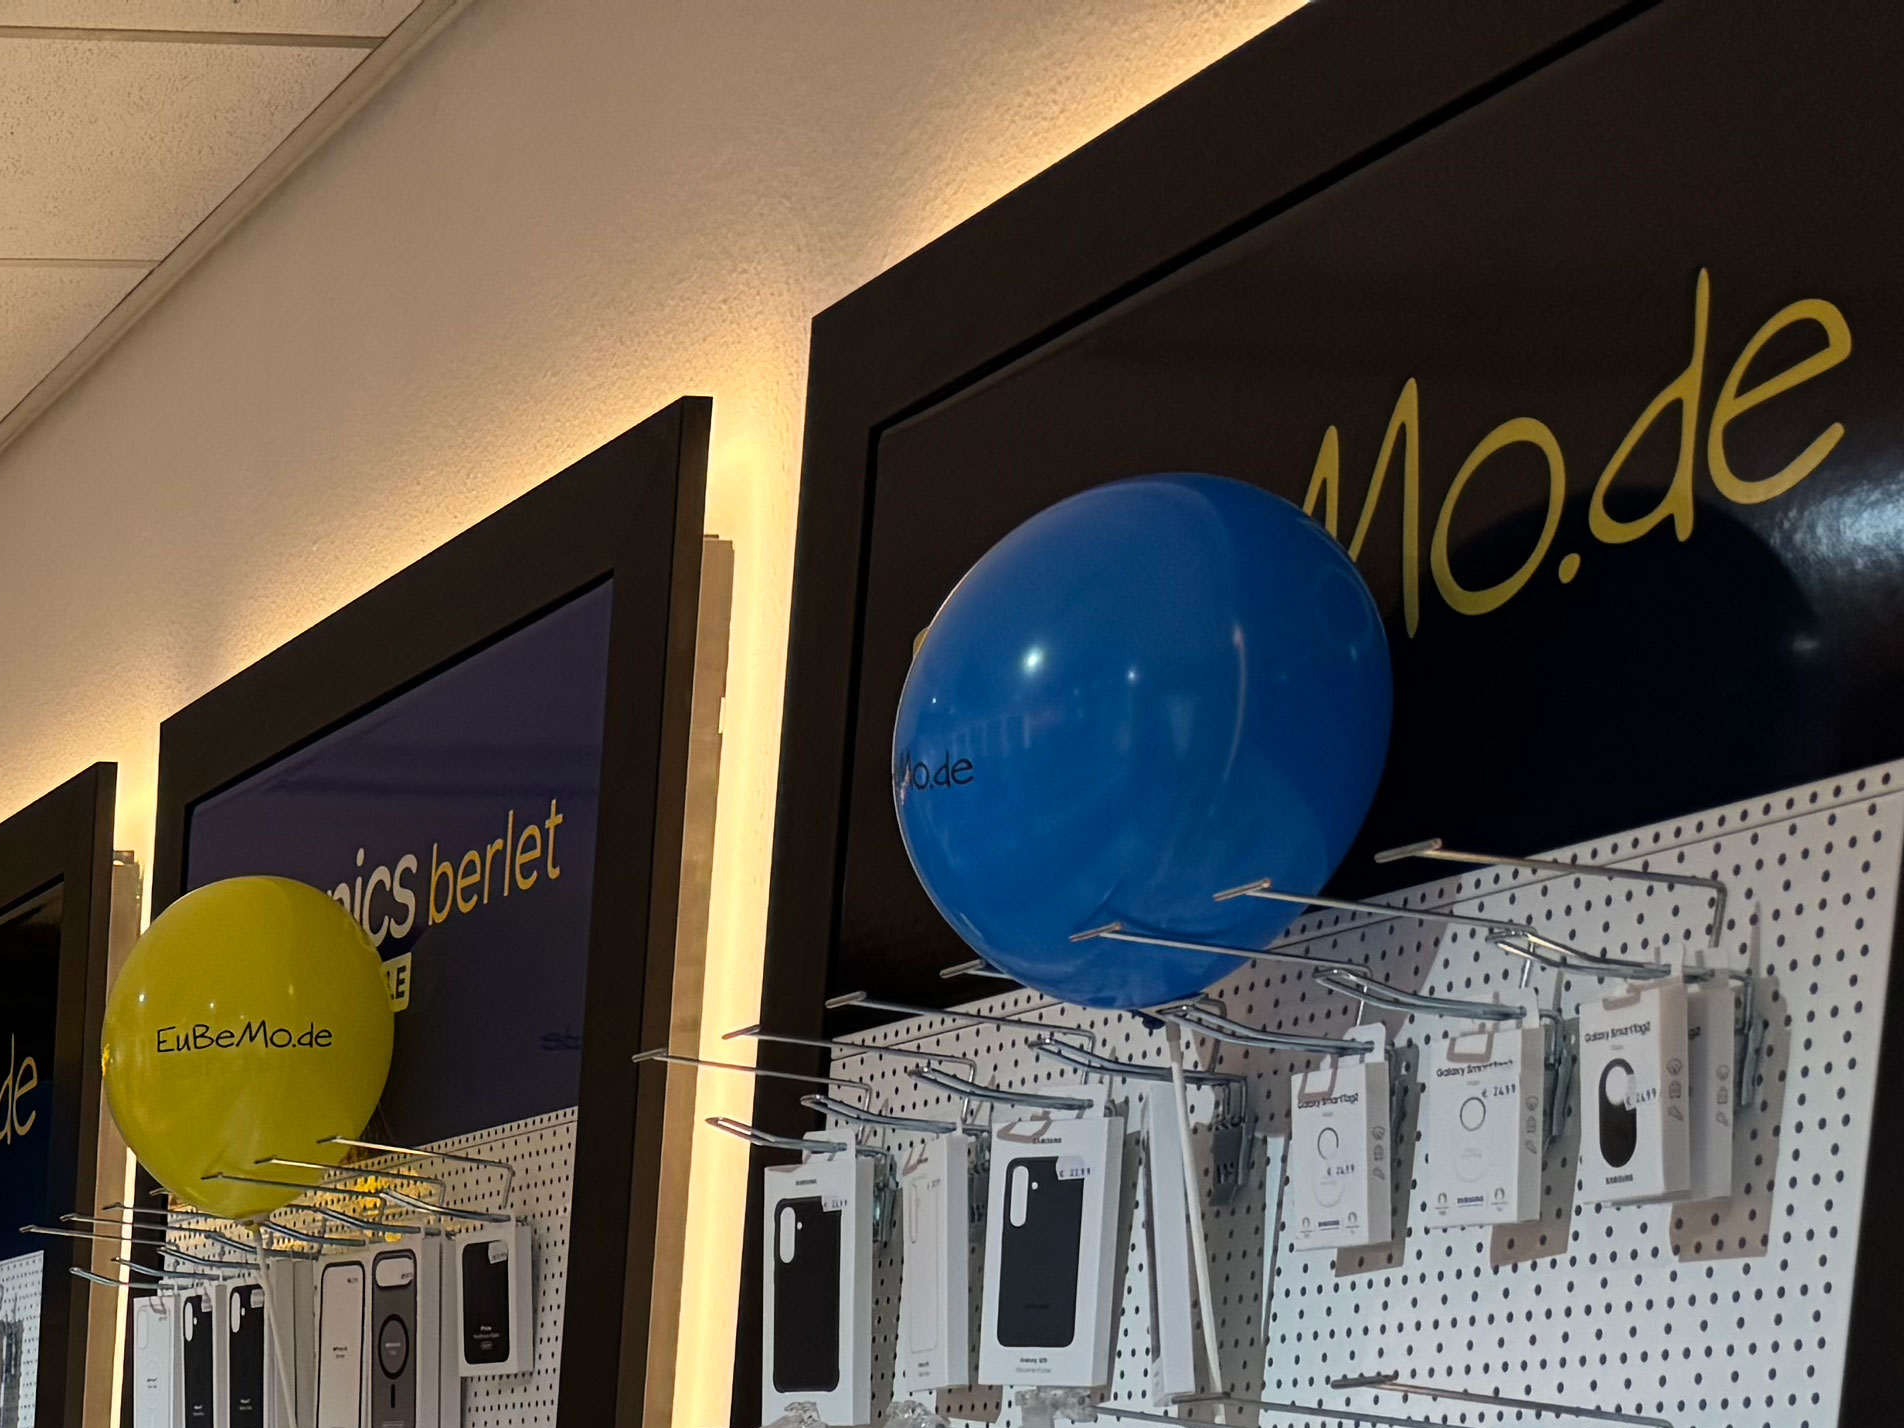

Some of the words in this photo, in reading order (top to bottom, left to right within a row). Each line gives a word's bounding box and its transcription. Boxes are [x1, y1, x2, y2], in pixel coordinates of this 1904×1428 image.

[1304, 267, 1853, 639] Mo.de
[894, 752, 974, 803] Mo.de
[326, 846, 419, 947] nics
[428, 798, 564, 926] berlet
[156, 1019, 333, 1054] EuBeMo.de
